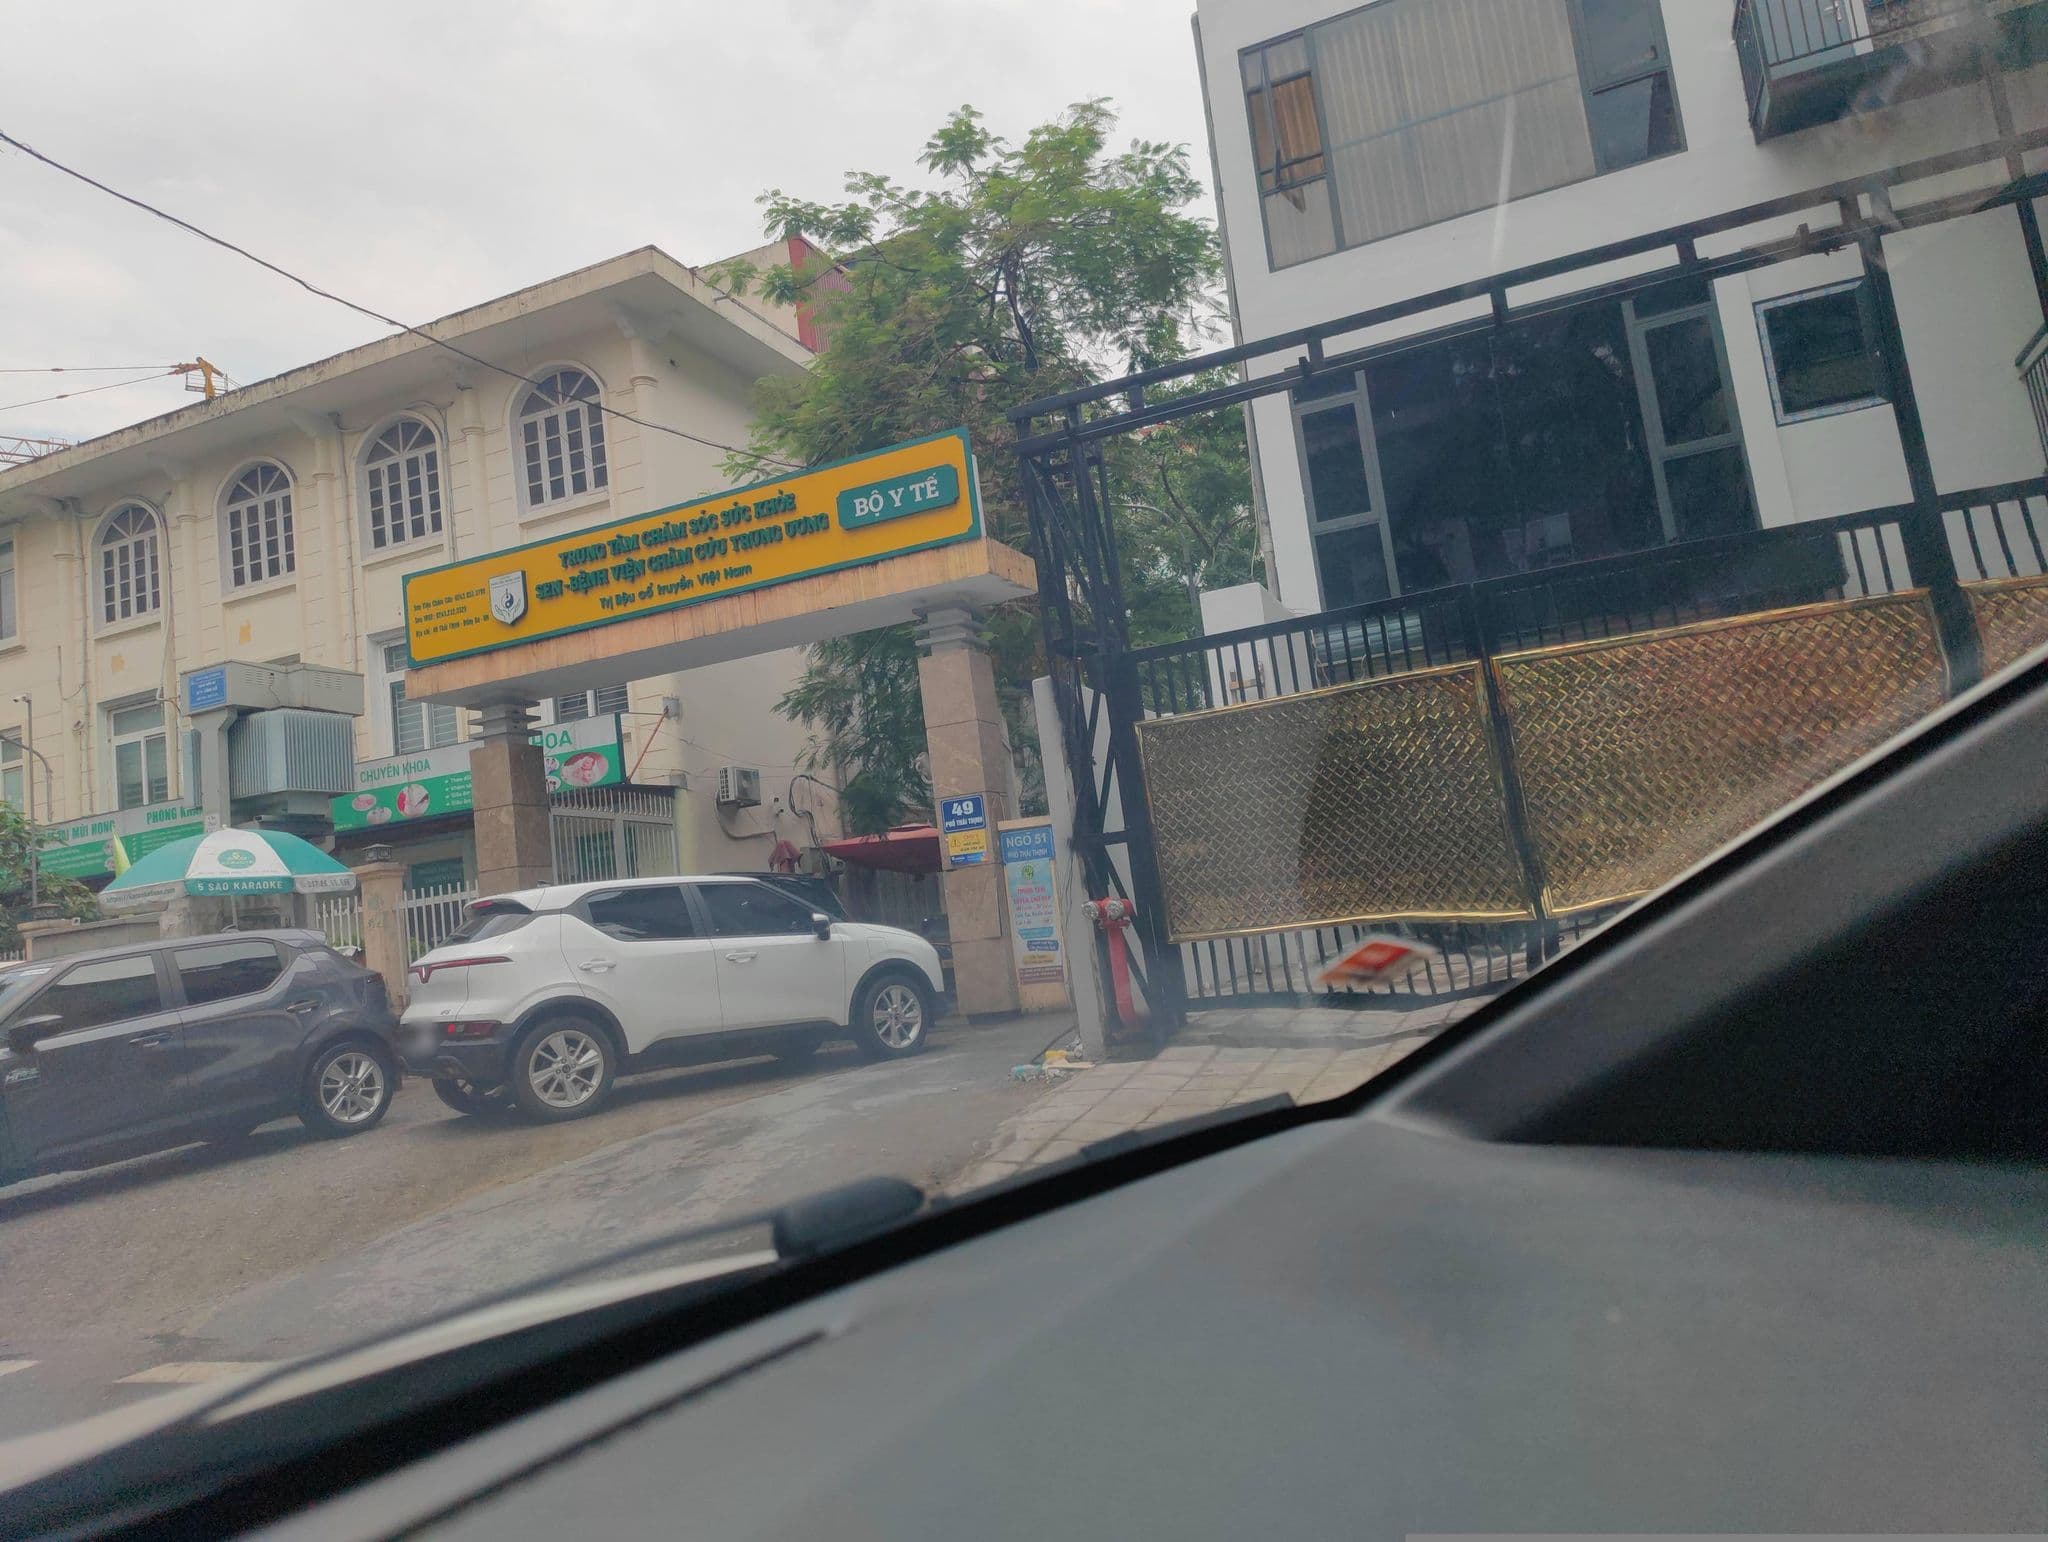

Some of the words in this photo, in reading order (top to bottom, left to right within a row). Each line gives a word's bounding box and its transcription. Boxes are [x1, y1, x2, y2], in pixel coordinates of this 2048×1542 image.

[853, 489, 884, 517] BỘ
[888, 487, 905, 508] Y
[909, 472, 940, 502] TẾ
[559, 543, 607, 568] TRUNG
[608, 534, 641, 556] TÂM
[641, 521, 689, 547] CHĂM
[689, 510, 719, 535] SÓC
[720, 502, 752, 527] SỨC
[754, 489, 797, 519] KHỎE
[535, 580, 563, 599] SEN
[611, 557, 646, 582] VIỆN
[648, 546, 693, 572] CHÂM
[695, 537, 728, 560] CỨU
[730, 525, 783, 552] TRUNG
[785, 513, 829, 538] ƯƠNG
[657, 575, 694, 595] truyền
[697, 570, 721, 586] Việt
[724, 565, 753, 580] Nam
[360, 762, 400, 783] CHUYÊN
[403, 759, 431, 775] KHOA
[951, 801, 974, 817] 49
[1006, 832, 1031, 848] NGÕ
[1035, 832, 1047, 845] 51
[197, 881, 204, 891] 5
[208, 881, 229, 891] SAO
[234, 880, 283, 890] KARAOKE
